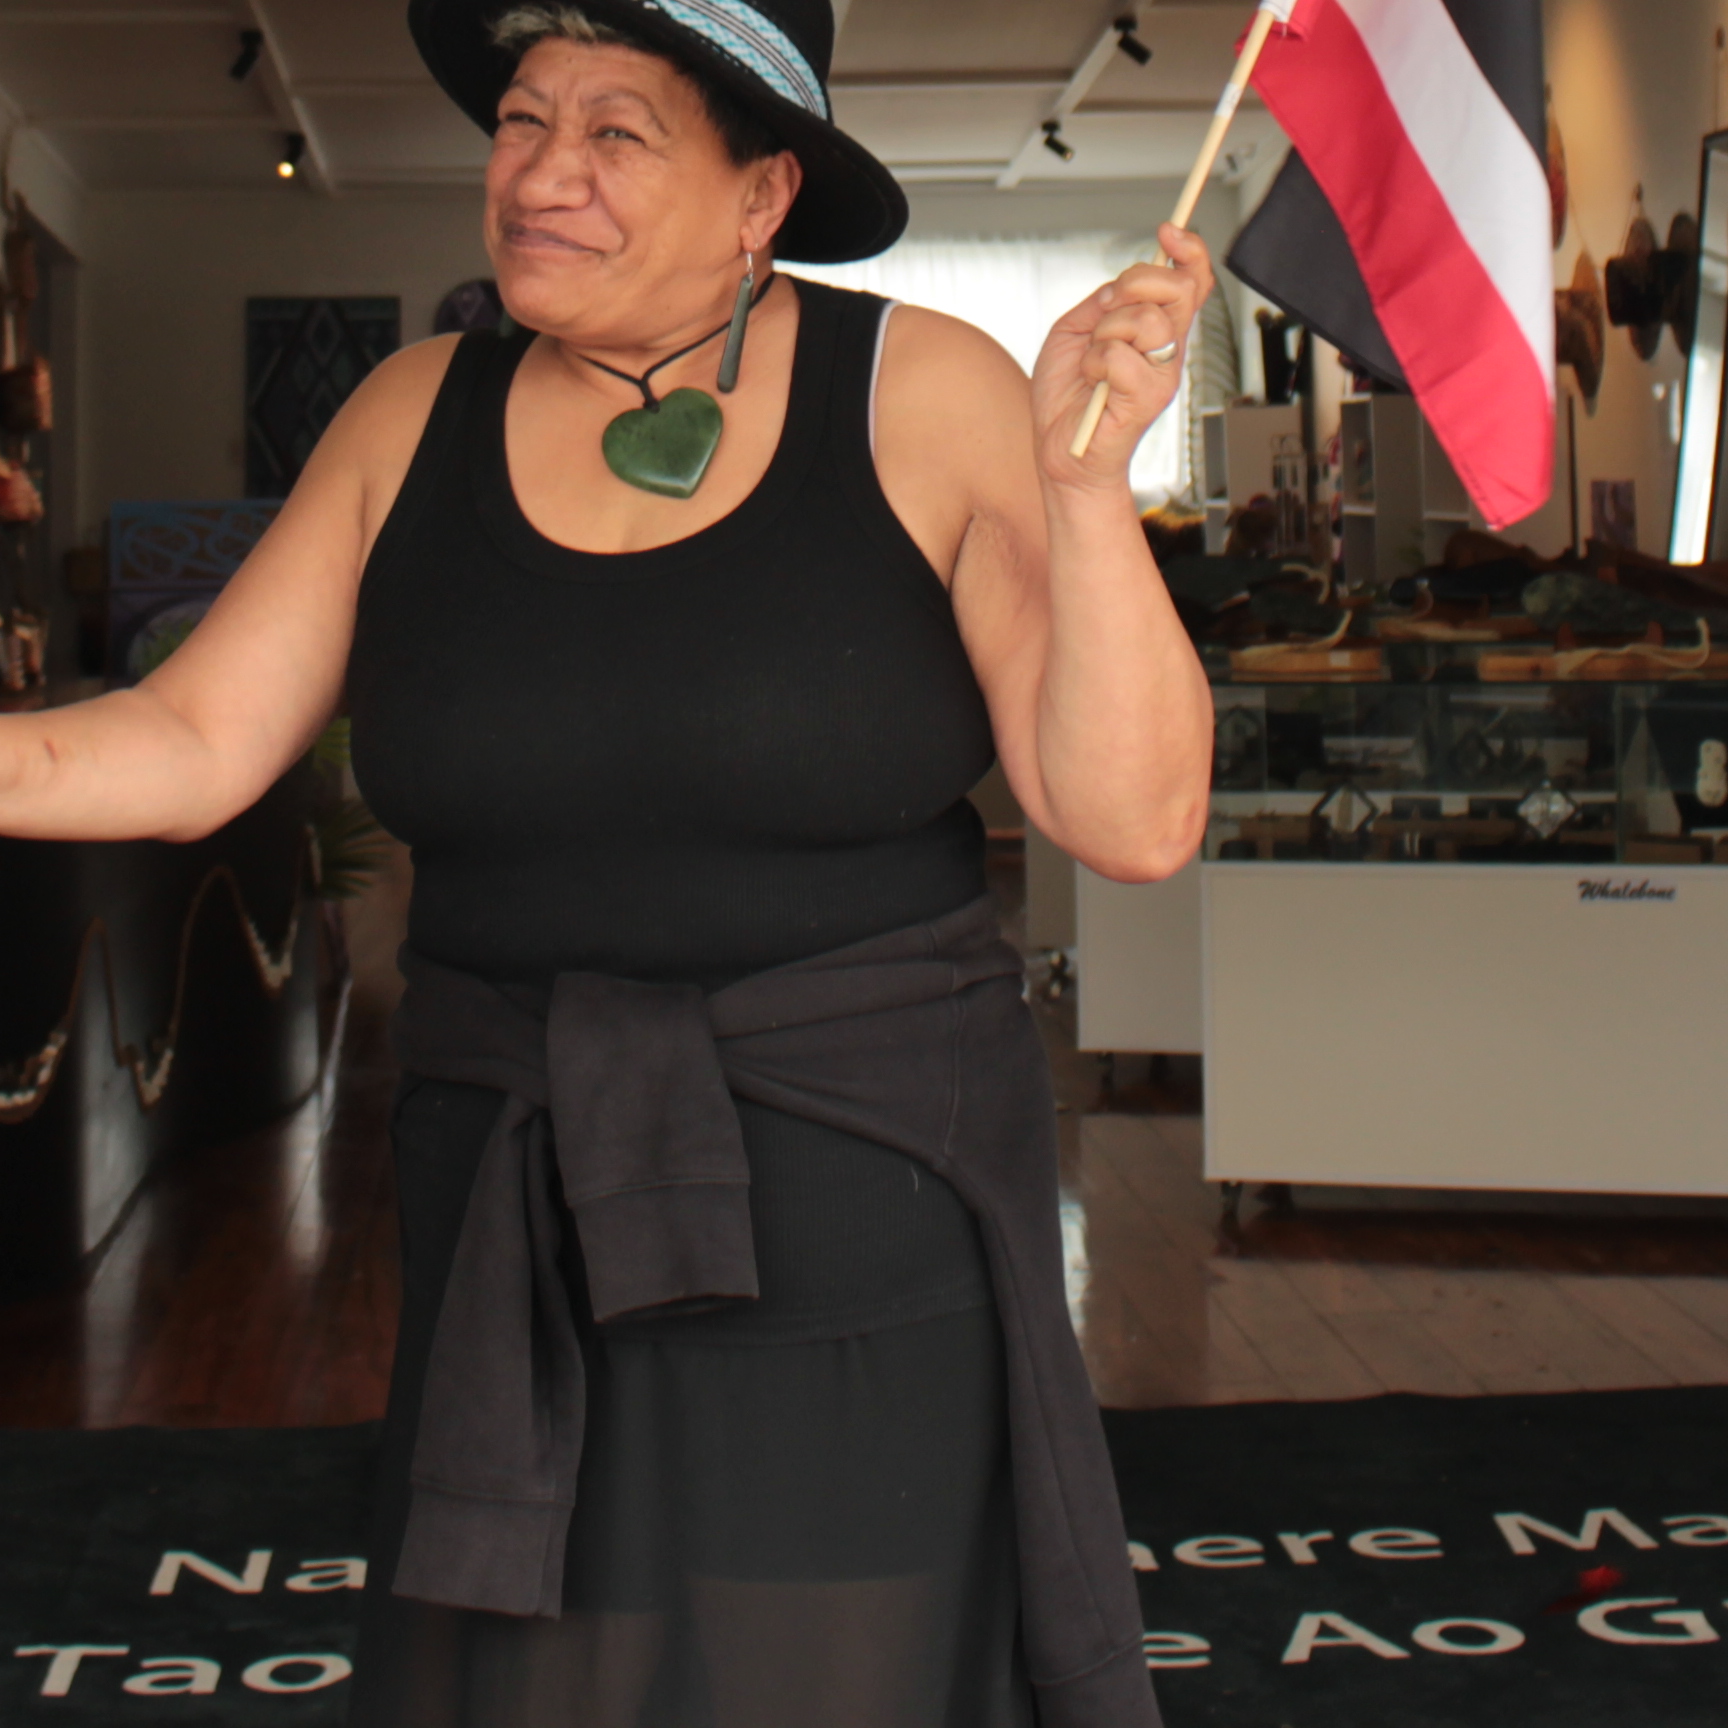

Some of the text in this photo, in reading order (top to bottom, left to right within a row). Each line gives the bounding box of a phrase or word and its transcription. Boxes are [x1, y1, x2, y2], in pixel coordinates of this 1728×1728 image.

[1576, 878, 1676, 902] Whalebone
[149, 1548, 368, 1596] Na
[14, 1643, 354, 1697] Tao
[1280, 1611, 1527, 1665] Ao
